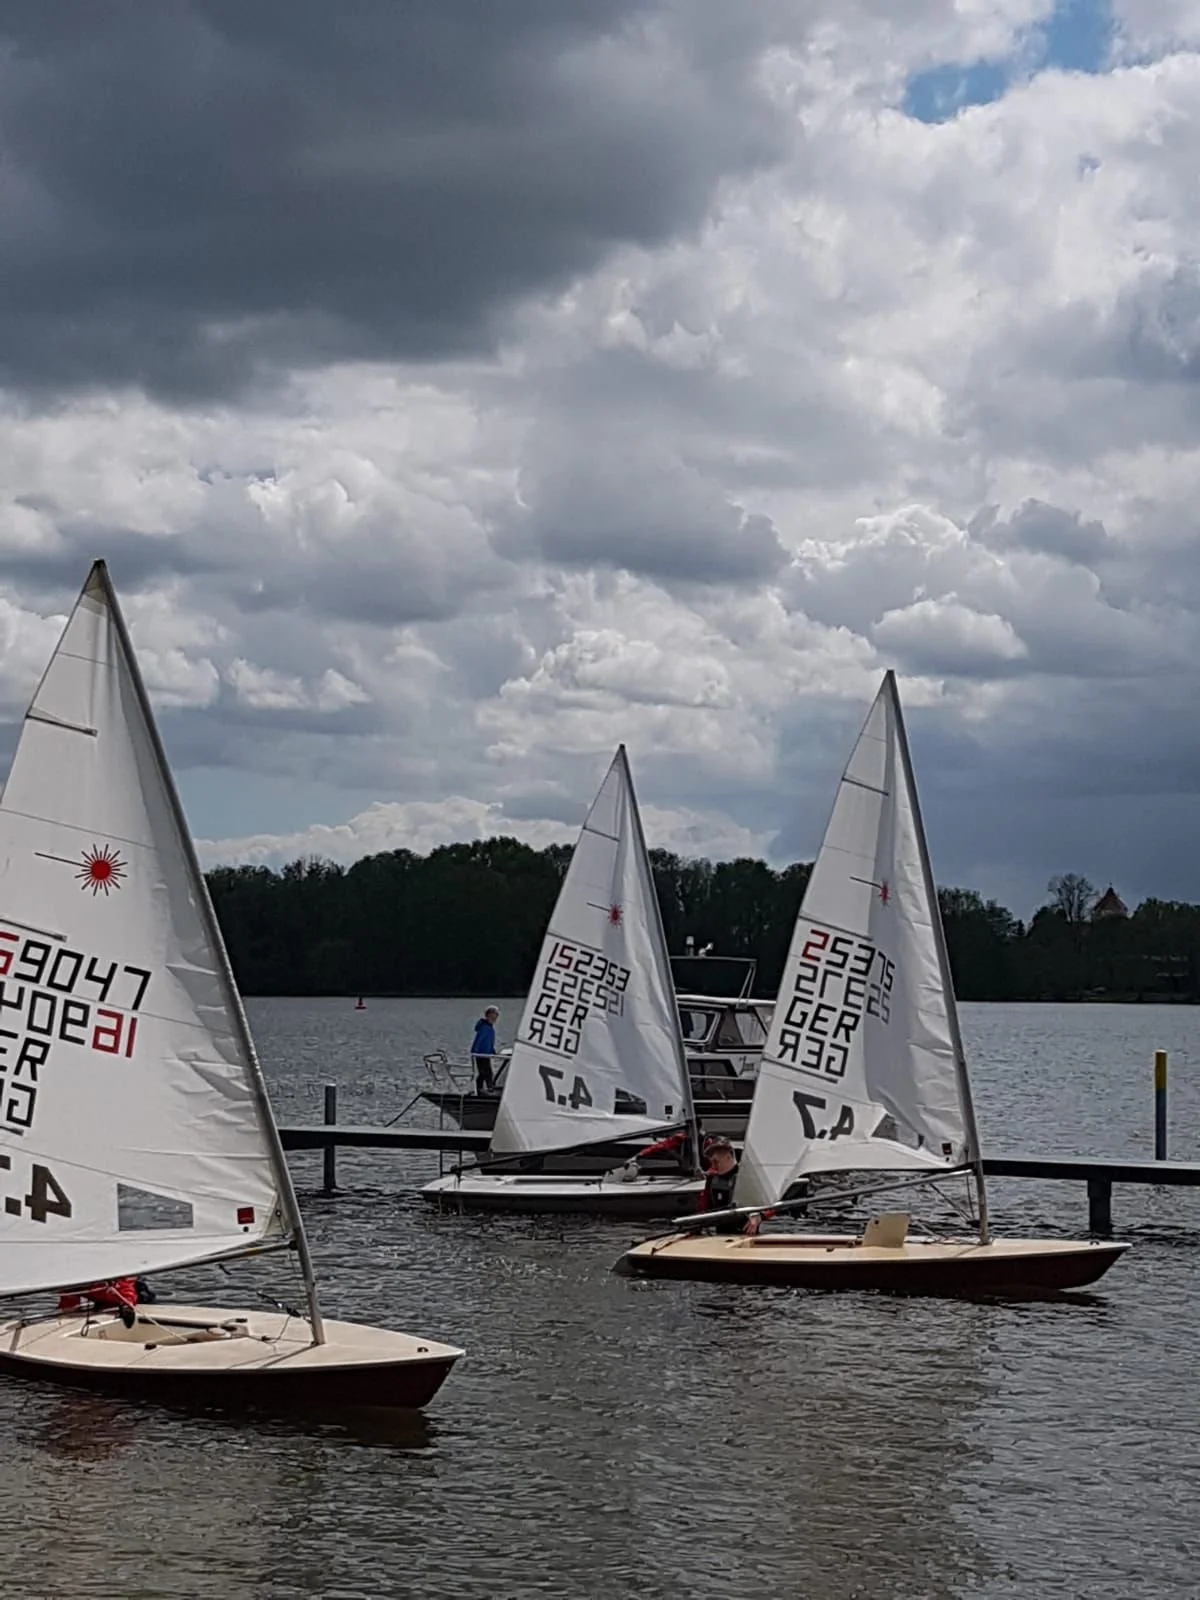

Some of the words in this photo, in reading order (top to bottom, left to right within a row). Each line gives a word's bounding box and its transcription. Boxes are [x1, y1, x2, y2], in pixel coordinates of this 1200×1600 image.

[548, 942, 631, 992] 152353
[802, 929, 895, 992] 25375
[534, 993, 589, 1029] GER
[784, 996, 861, 1043] GER
